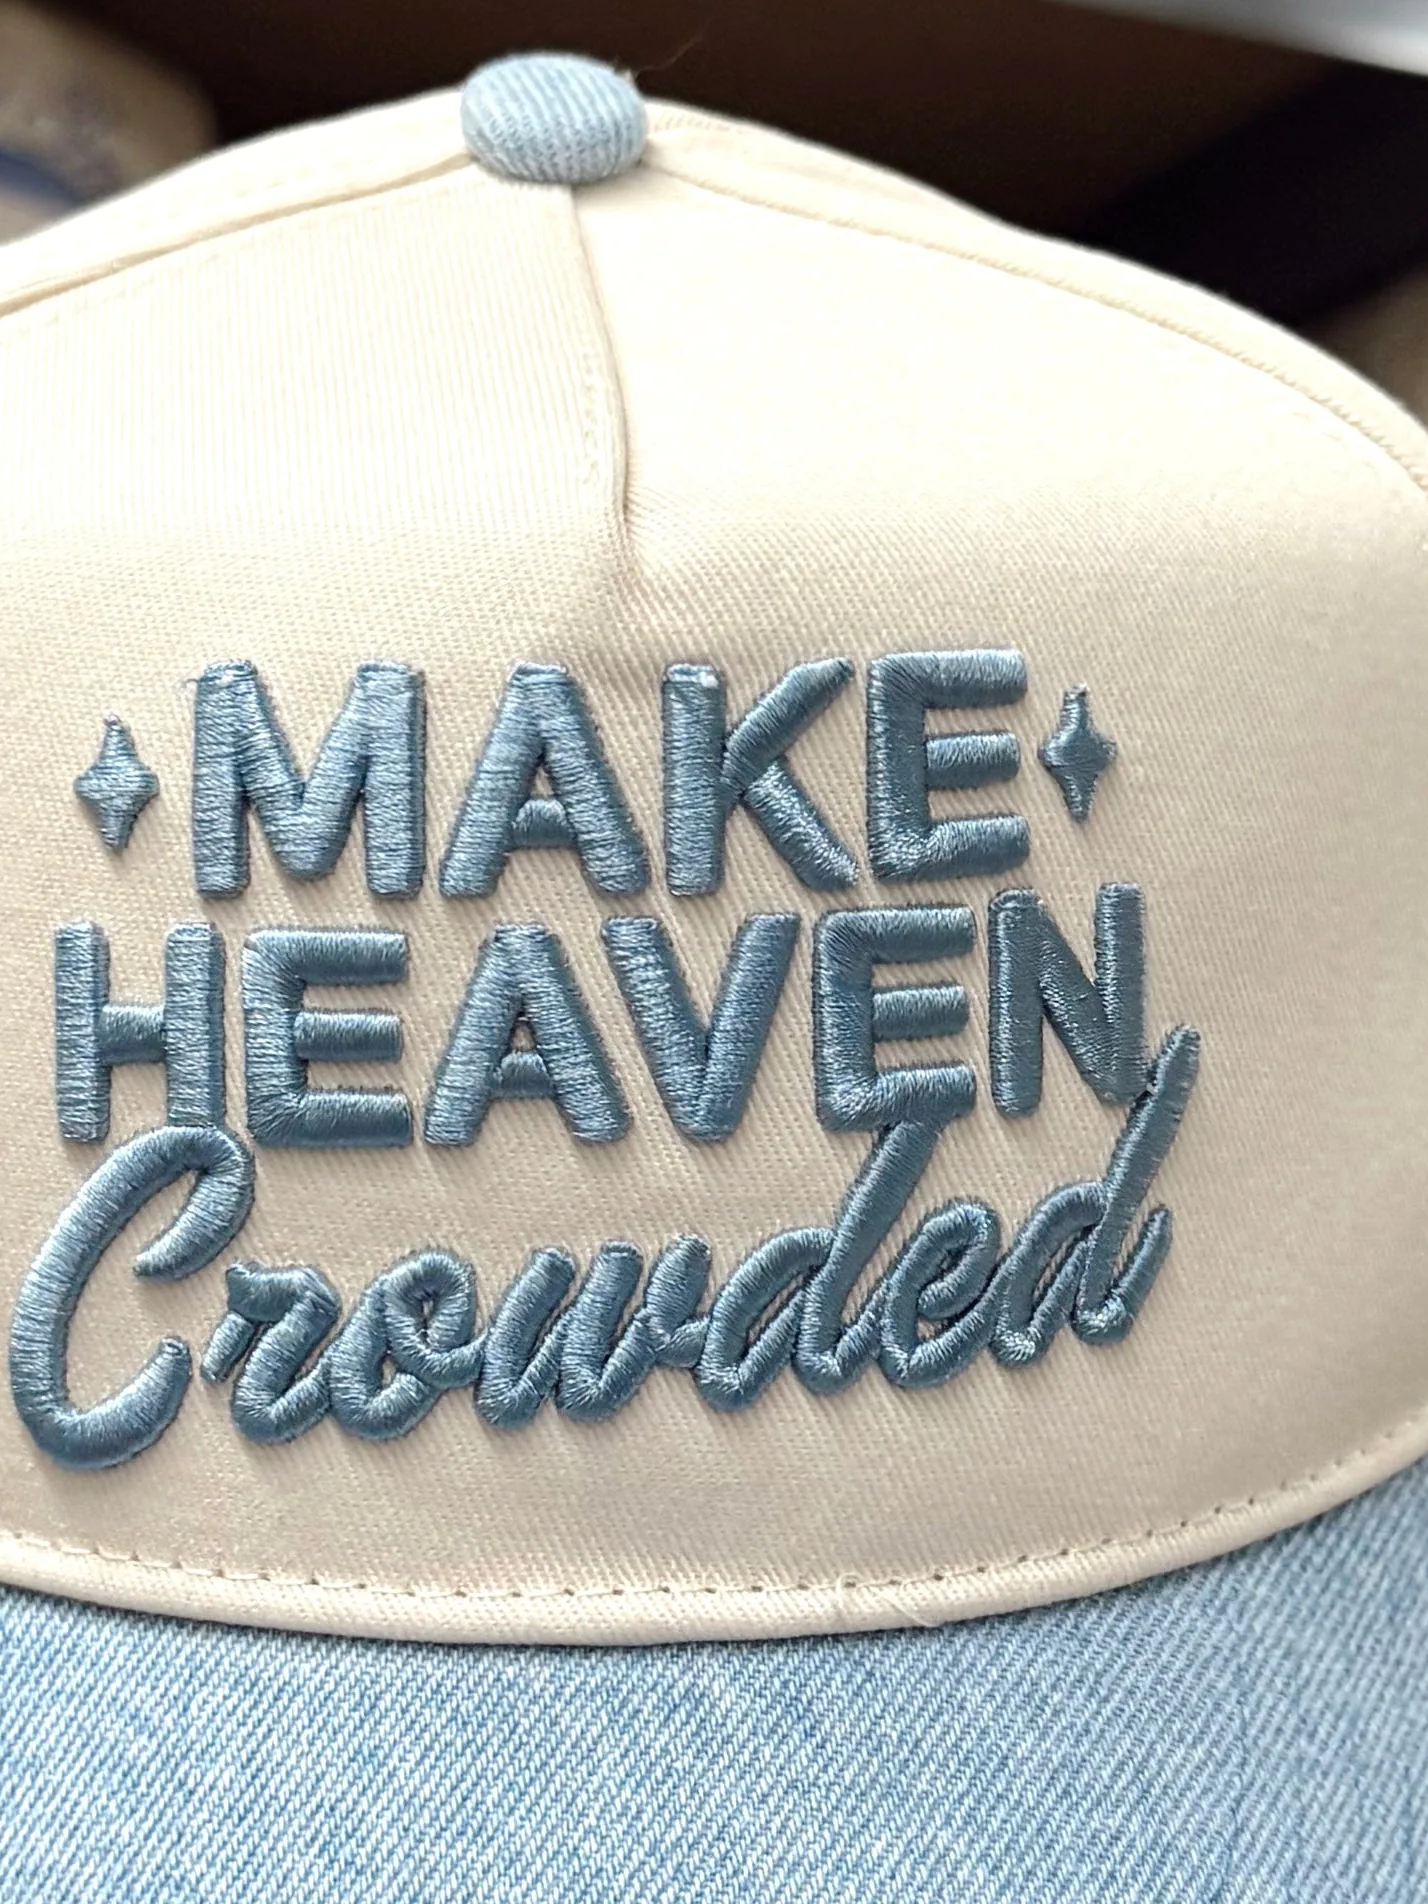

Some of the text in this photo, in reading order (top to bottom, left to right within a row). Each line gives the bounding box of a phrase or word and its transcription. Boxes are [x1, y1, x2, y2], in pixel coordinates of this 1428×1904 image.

[189, 646, 1030, 896] MAKE
[53, 882, 1150, 1148] HEAVEN
[9, 1024, 1202, 1471] Crowded
